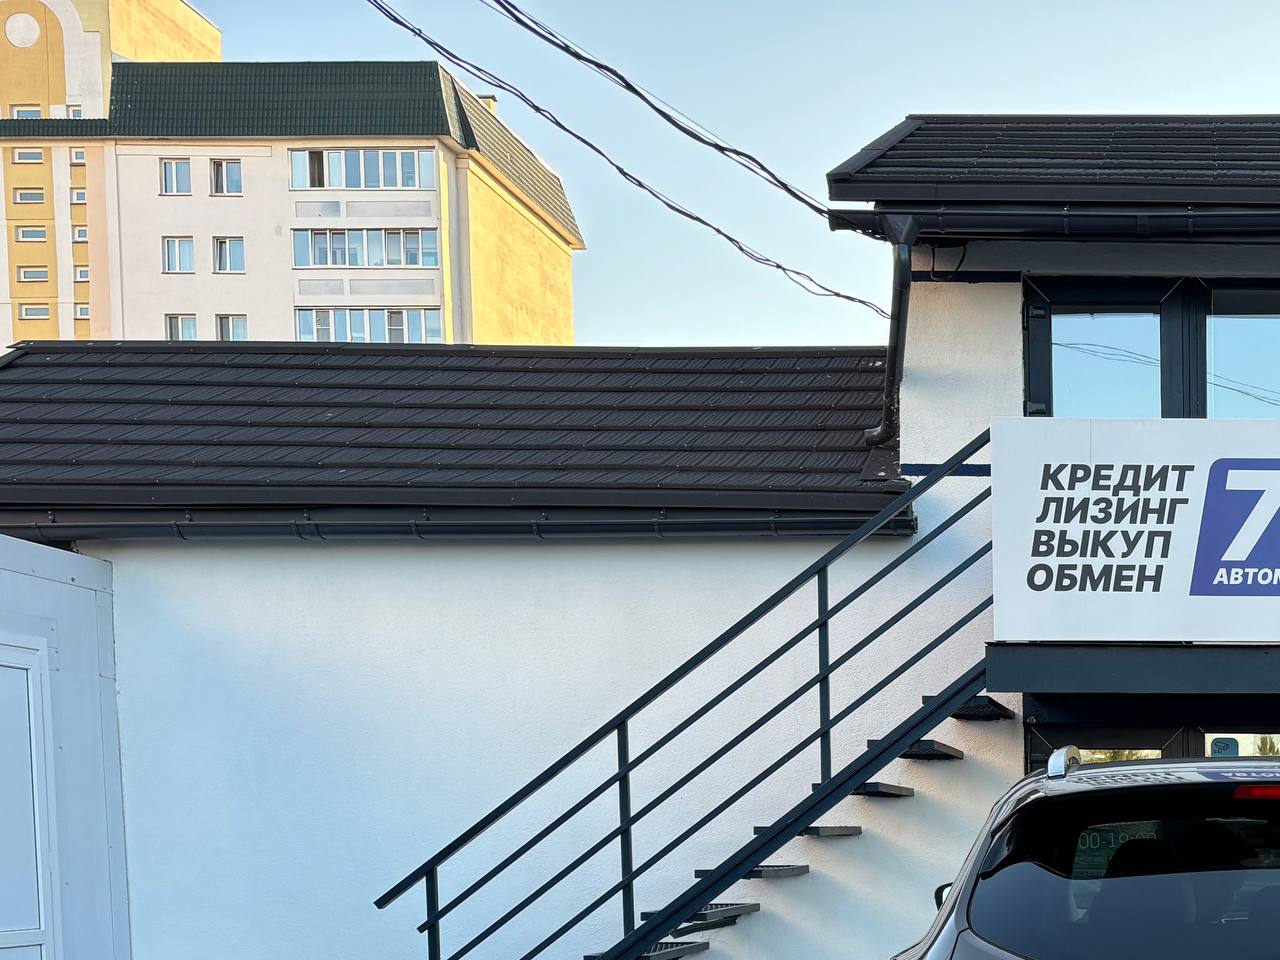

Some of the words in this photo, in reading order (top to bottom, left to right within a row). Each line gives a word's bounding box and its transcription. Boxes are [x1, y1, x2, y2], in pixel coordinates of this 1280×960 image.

[1040, 464, 1195, 497] КРЕДИТ
[1036, 497, 1189, 524] ЛИЗИНГ
[1031, 530, 1172, 558] ВЫКУП
[1026, 563, 1164, 592] ОБМЕН
